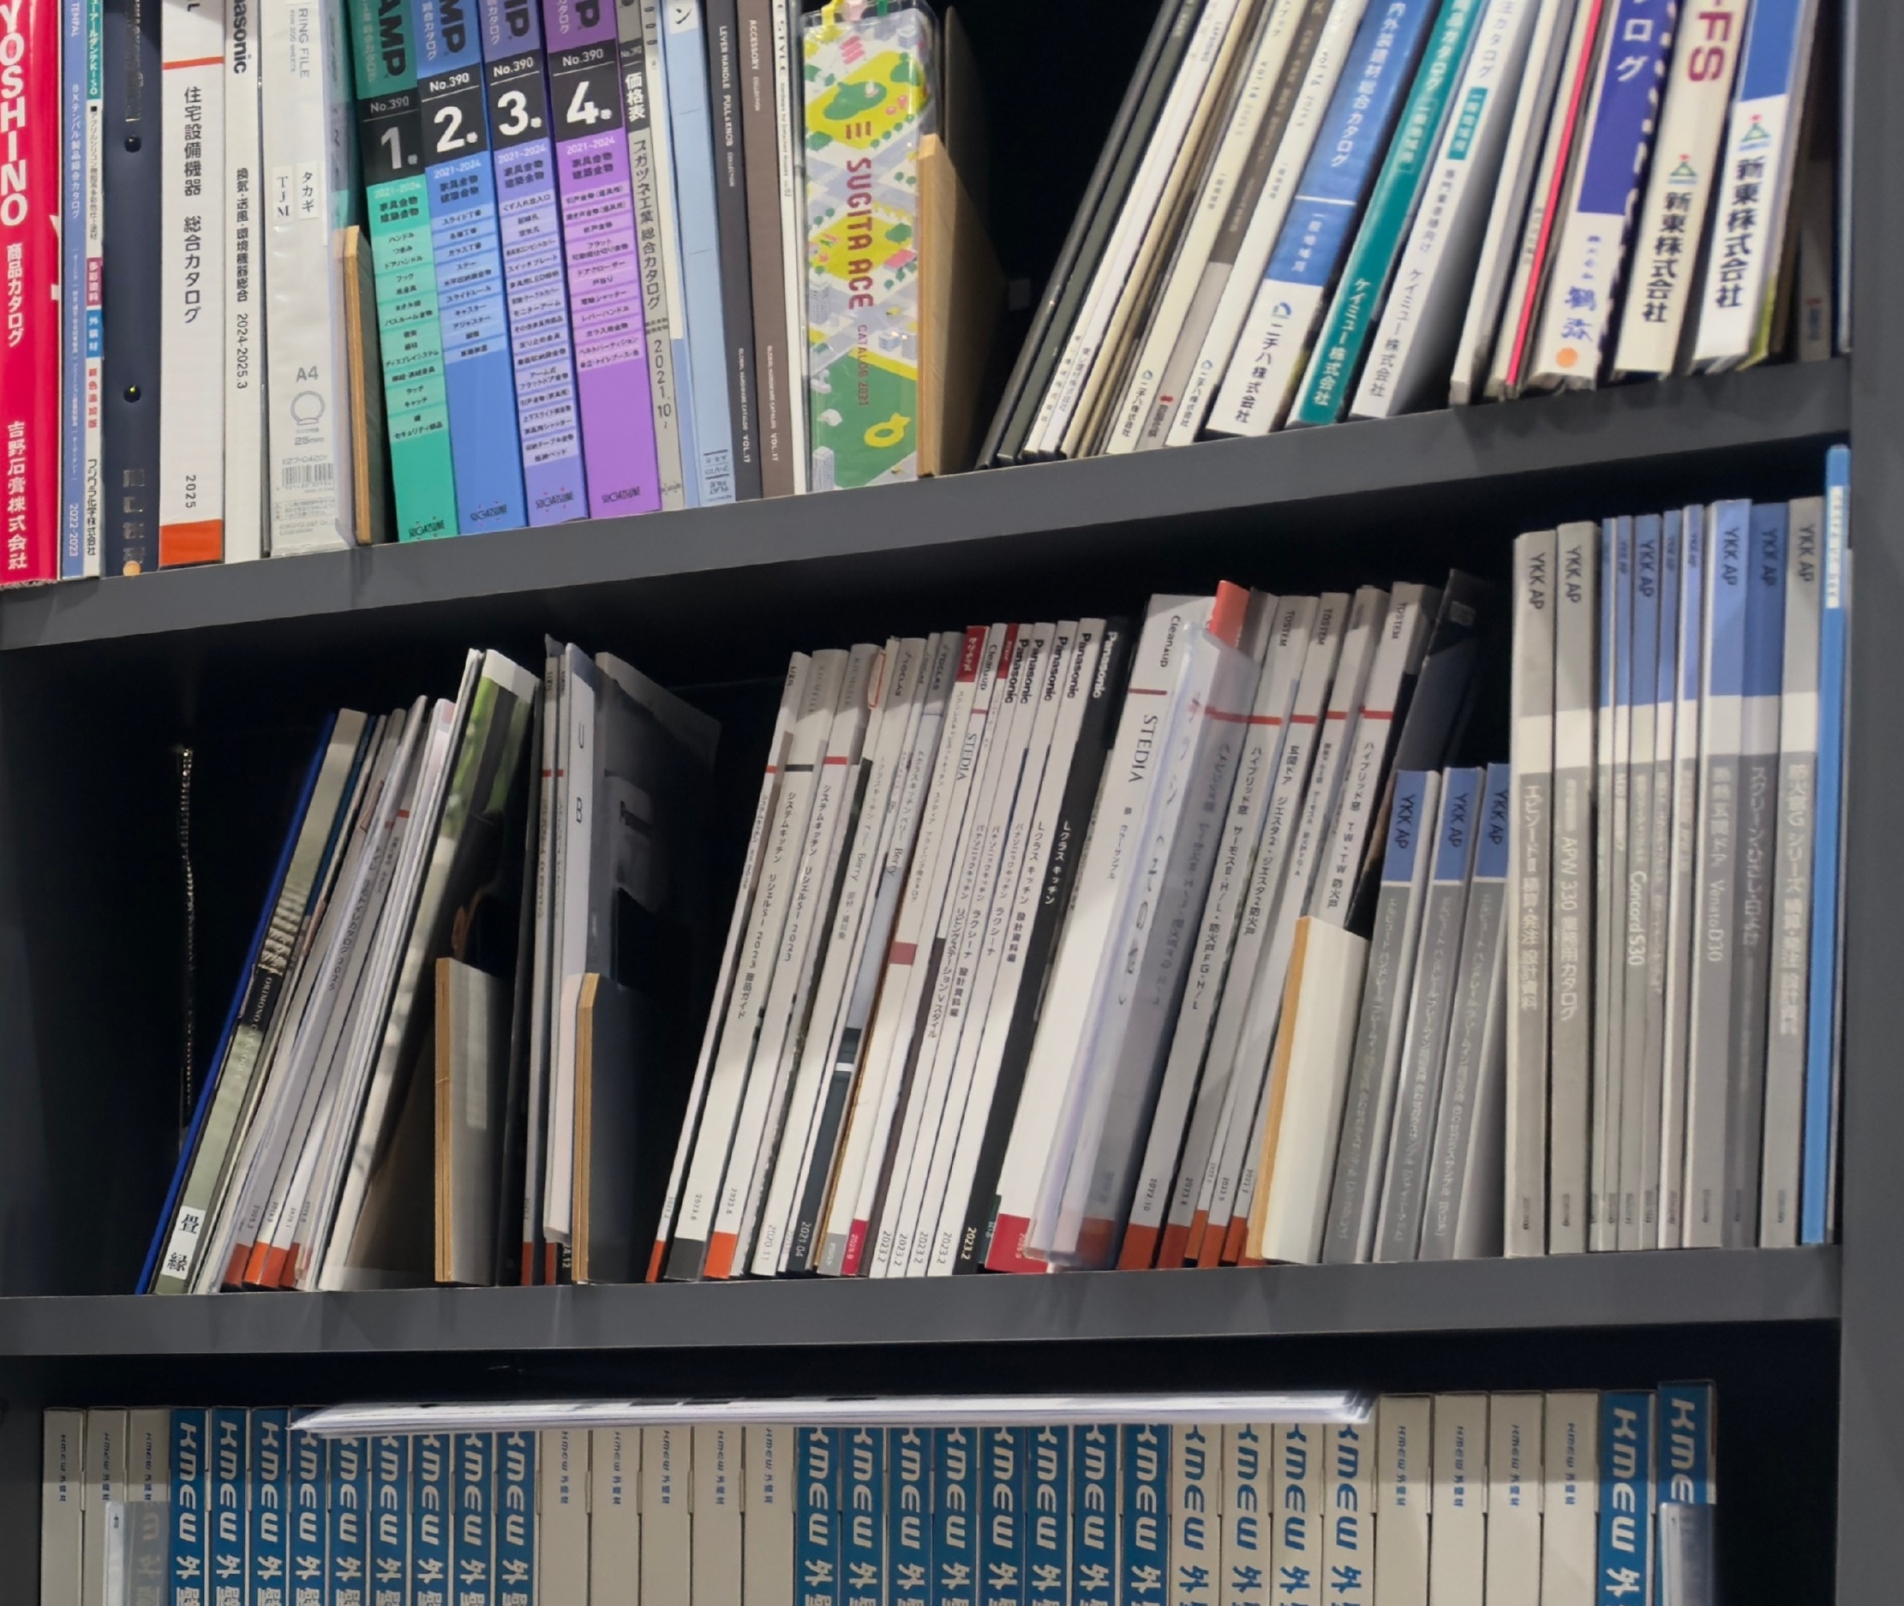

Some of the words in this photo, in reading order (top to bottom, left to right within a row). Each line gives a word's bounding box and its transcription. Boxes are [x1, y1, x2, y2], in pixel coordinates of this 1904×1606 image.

[298, 8, 309, 45] RING
[299, 48, 310, 78] FILE
[429, 72, 470, 92] No.390
[493, 57, 534, 77] No.390
[562, 49, 604, 67] No.390
[625, 73, 646, 120] 価格表
[184, 86, 202, 196] 住宅設備機器
[302, 171, 315, 212] タカギ
[846, 158, 873, 250] SUGITA
[1644, 192, 1694, 323] 新東株式会社
[1716, 158, 1766, 308] 新東株式会社
[183, 215, 202, 324] 総合カタログ
[641, 227, 662, 310] 総合カタログ
[848, 259, 874, 310] ACE
[7, 243, 25, 348] 商品カタログ
[237, 313, 248, 390] 2024-2025.3
[1314, 278, 1372, 406] ケイミュー株式会社
[296, 366, 319, 382] A4
[7, 420, 28, 570] 吉野石膏株式会社
[185, 474, 197, 510] 2025
[68, 502, 79, 557] 2022-2023
[1723, 527, 1740, 560] YKK
[1530, 551, 1546, 585] YKK
[1567, 545, 1583, 578] YKK
[1722, 562, 1737, 587] AP
[1530, 588, 1545, 611] AP
[1567, 580, 1581, 604] AP
[1044, 635, 1068, 702] Panasonic
[1067, 632, 1091, 698] Panasonic
[1093, 631, 1118, 698] Panasonic
[1129, 714, 1158, 783] STEDIA
